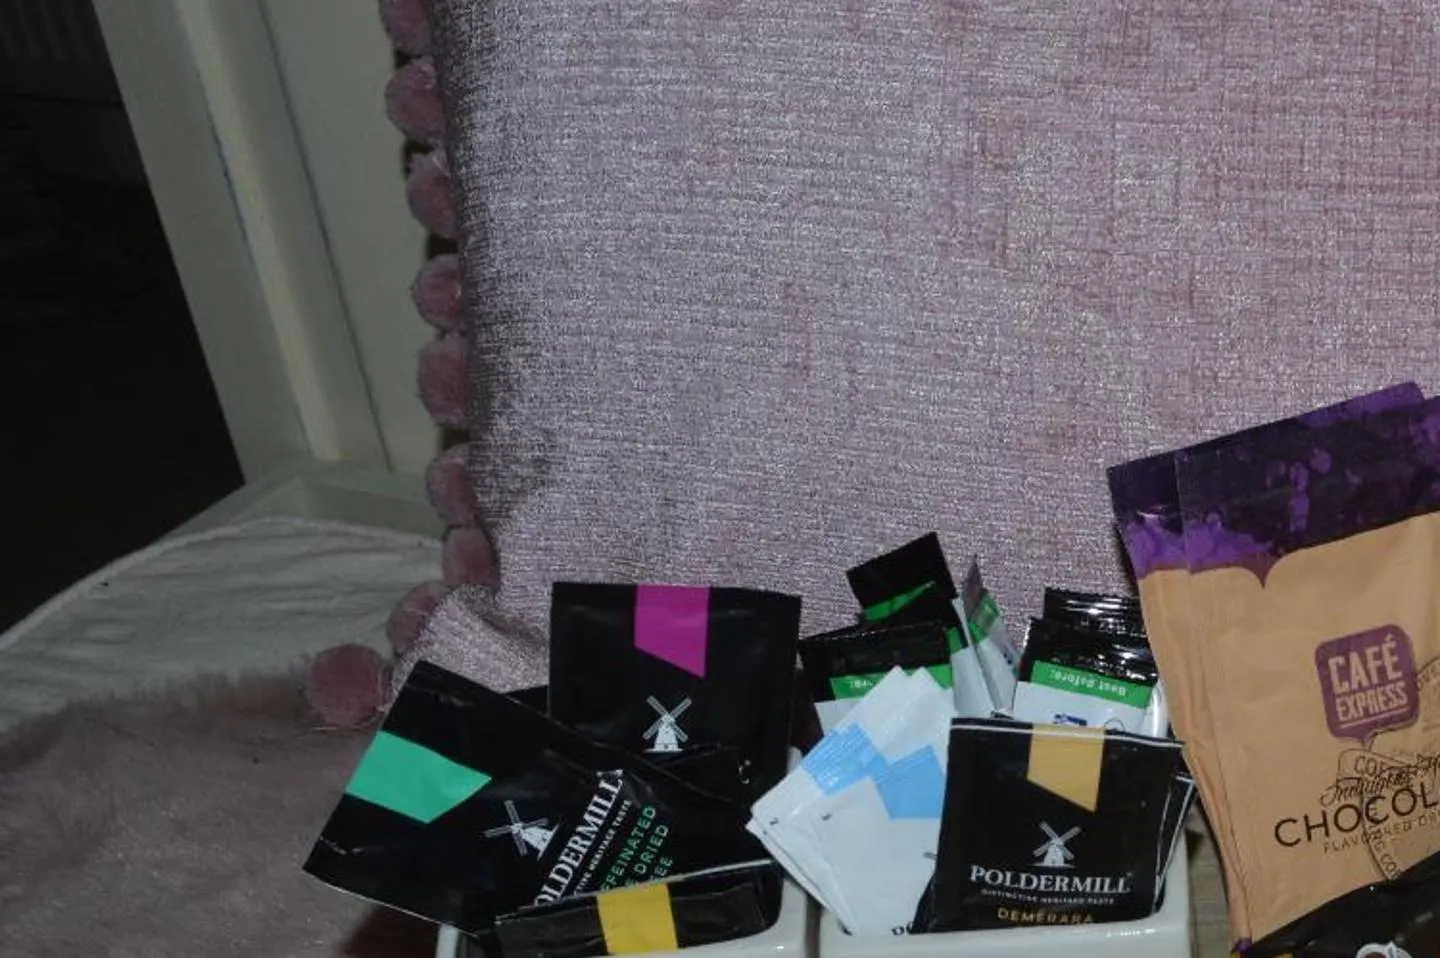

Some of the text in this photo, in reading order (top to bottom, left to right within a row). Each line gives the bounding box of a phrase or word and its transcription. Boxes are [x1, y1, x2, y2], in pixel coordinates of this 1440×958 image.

[1328, 633, 1402, 695] CAFÉ
[1336, 682, 1409, 722] EXPRESS
[535, 778, 623, 906] OLDERMILL
[601, 805, 656, 891] FFEINATED
[633, 824, 669, 875] DRIED
[970, 864, 1132, 894] POLDERMILL
[997, 907, 1094, 925] DEMERARA
